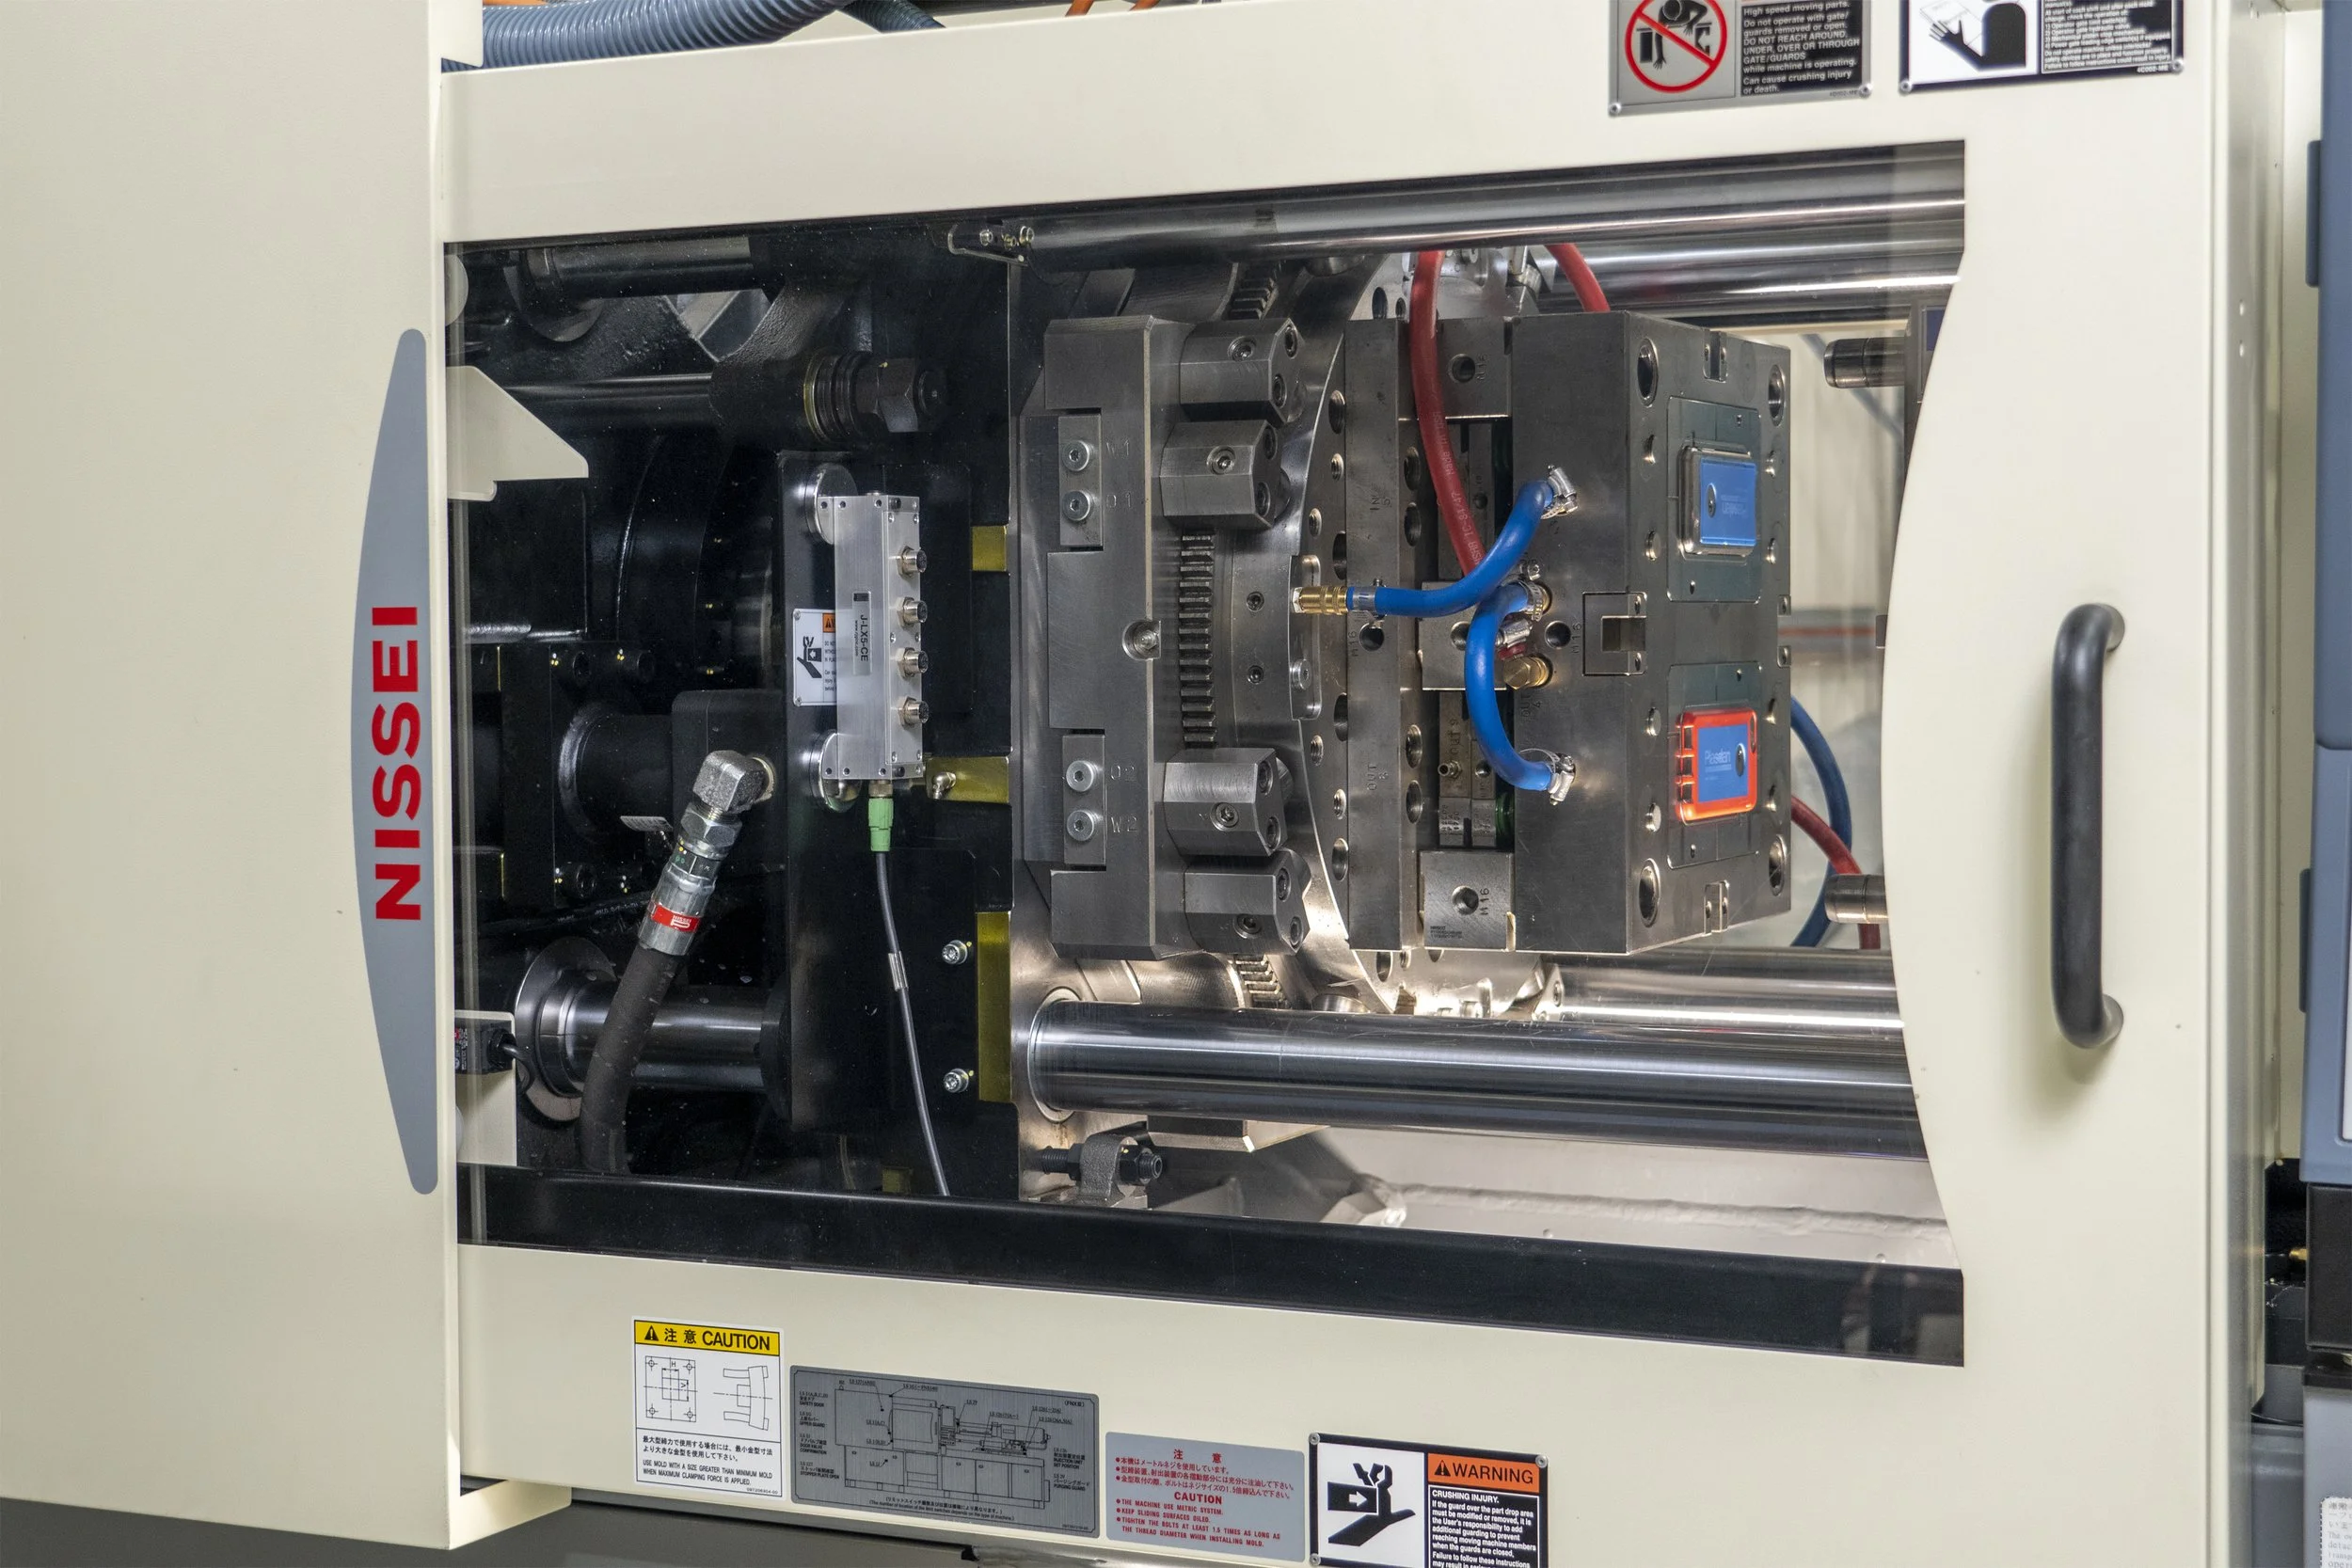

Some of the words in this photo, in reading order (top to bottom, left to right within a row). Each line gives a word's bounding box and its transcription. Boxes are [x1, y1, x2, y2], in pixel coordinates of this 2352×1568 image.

[1744, 8, 1763, 17] High
[1766, 6, 1789, 15] speed
[1792, 2, 1824, 13] moving
[1773, 15, 1804, 25] operate
[1806, 13, 1825, 22] with
[1744, 28, 1772, 38] guards
[1774, 24, 1810, 34] removed
[1758, 36, 1775, 44] NOT
[1778, 33, 1807, 42] REACH
[1777, 43, 1801, 52] OVER
[1803, 41, 1816, 50] OR
[1818, 38, 1860, 49] THROUGH
[1743, 52, 1806, 64] GATE/GUARDS
[1743, 65, 1765, 73] while
[1767, 62, 1803, 71] machine
[1743, 76, 1760, 85] Can
[1762, 75, 1787, 84] cause
[1788, 71, 1825, 83] crushing
[1827, 70, 1851, 80] injury
[860, 614, 869, 661] J-LX5-CE
[372, 607, 421, 920] NISSEI
[1480, 888, 1489, 915] M16
[664, 1328, 696, 1343] 注意
[702, 1330, 770, 1351] CAUTION
[654, 1459, 667, 1467] MOLD
[699, 1465, 720, 1473] GREATER
[737, 1468, 756, 1477] MINIMUM
[1453, 1463, 1534, 1483] WARNING
[682, 1471, 705, 1480] CLAMPING
[707, 1474, 723, 1482] FORCE
[1174, 1492, 1222, 1505] CAUTION
[1433, 1490, 1470, 1500] CRUSHING
[1448, 1501, 1465, 1511] guard
[1505, 1508, 1518, 1516] drop
[1457, 1511, 1483, 1520] modified
[1463, 1520, 1502, 1531] responsibility
[1136, 1527, 1156, 1535] THREAD
[1160, 1529, 1186, 1538] DIAMETER
[1210, 1535, 1242, 1544] INSTALLING
[1433, 1526, 1461, 1534] additional
[1462, 1528, 1488, 1538] guarding
[1498, 1532, 1520, 1541] prevent
[1433, 1533, 1457, 1543] reaching
[1459, 1536, 1481, 1545] moving
[1483, 1539, 1507, 1547] machine
[1509, 1542, 1535, 1550] members
[1460, 1544, 1481, 1554] guards
[1433, 1551, 1452, 1560] Failure
[1460, 1554, 1477, 1562] follow
[1479, 1556, 1494, 1564] these
[1496, 1559, 1530, 1568] instructions
